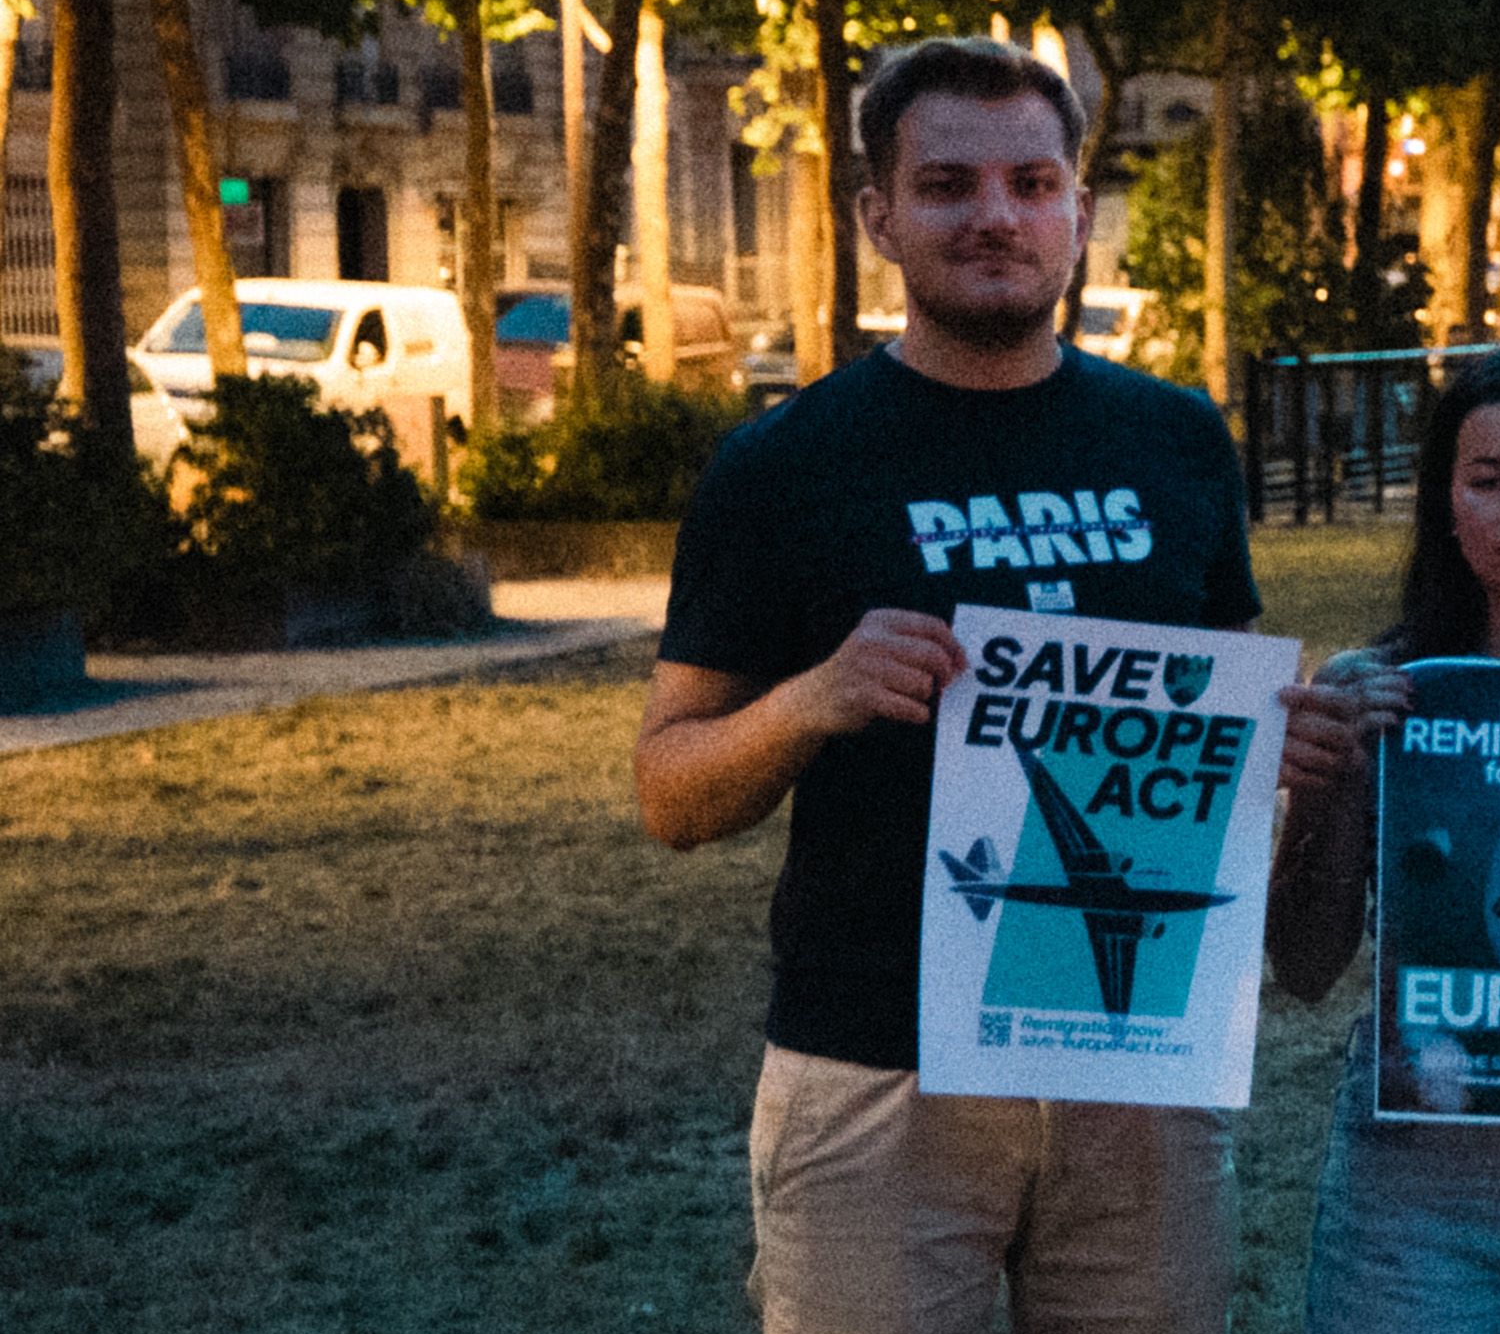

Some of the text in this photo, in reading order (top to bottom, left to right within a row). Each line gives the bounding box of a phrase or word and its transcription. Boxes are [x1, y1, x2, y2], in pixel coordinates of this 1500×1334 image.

[906, 488, 1152, 573] PARIS
[975, 636, 1161, 700] SAVE
[965, 694, 1248, 765] EUROPE
[1085, 764, 1230, 822] ACT
